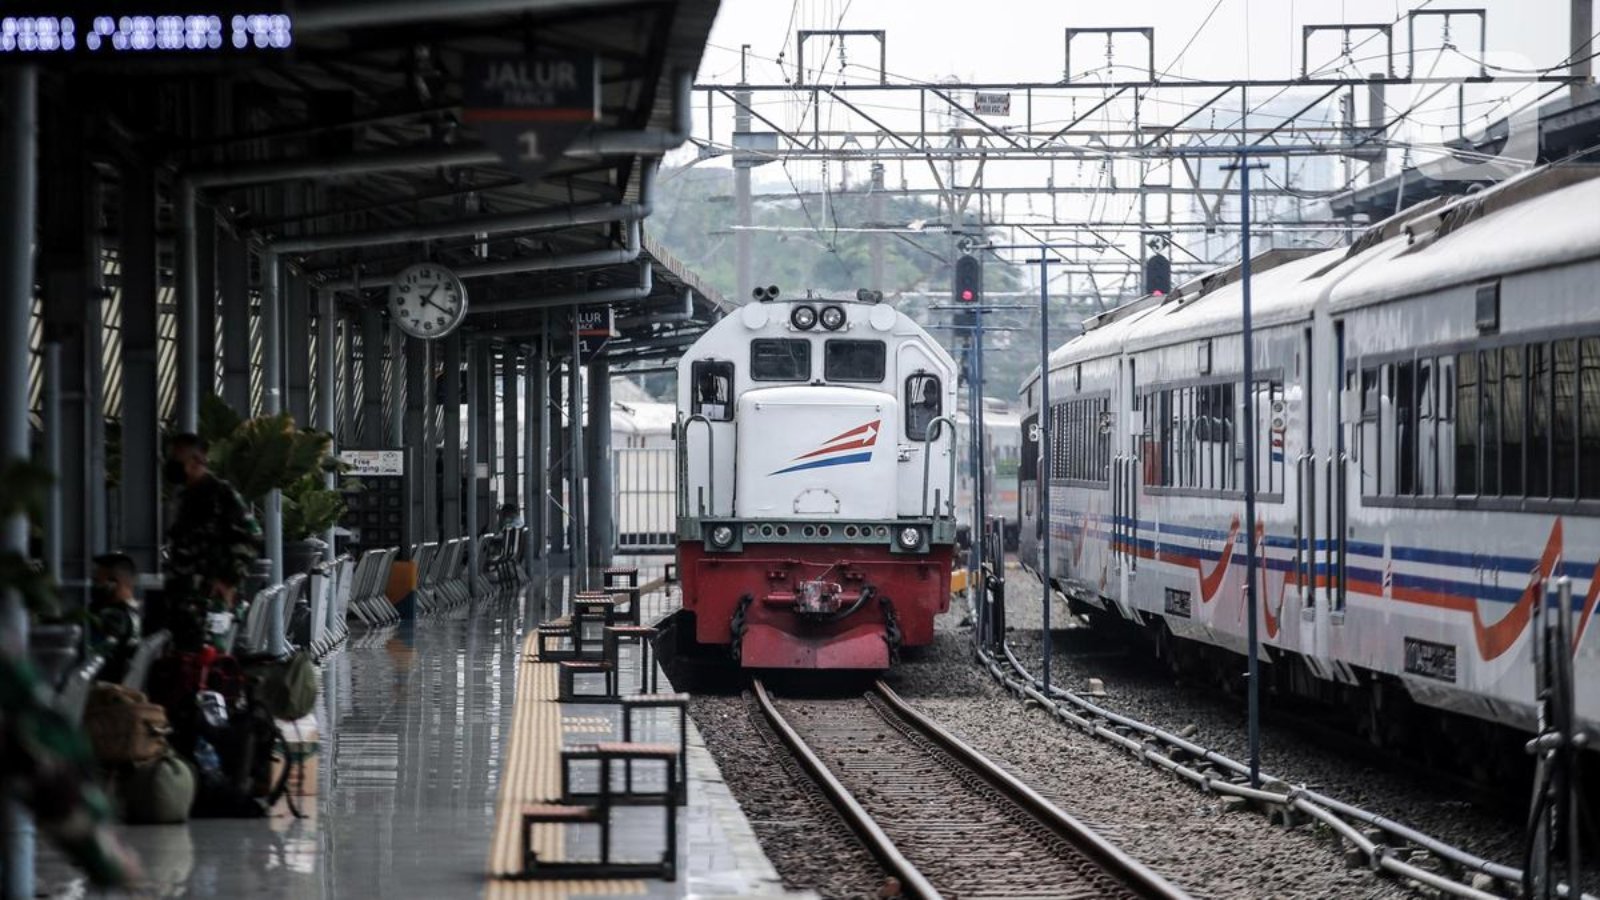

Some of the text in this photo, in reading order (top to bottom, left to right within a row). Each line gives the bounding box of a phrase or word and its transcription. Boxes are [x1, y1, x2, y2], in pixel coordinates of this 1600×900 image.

[484, 62, 576, 89] JALUR
[517, 131, 545, 160] 1
[962, 237, 973, 255] 3
[1152, 235, 1164, 253] 3
